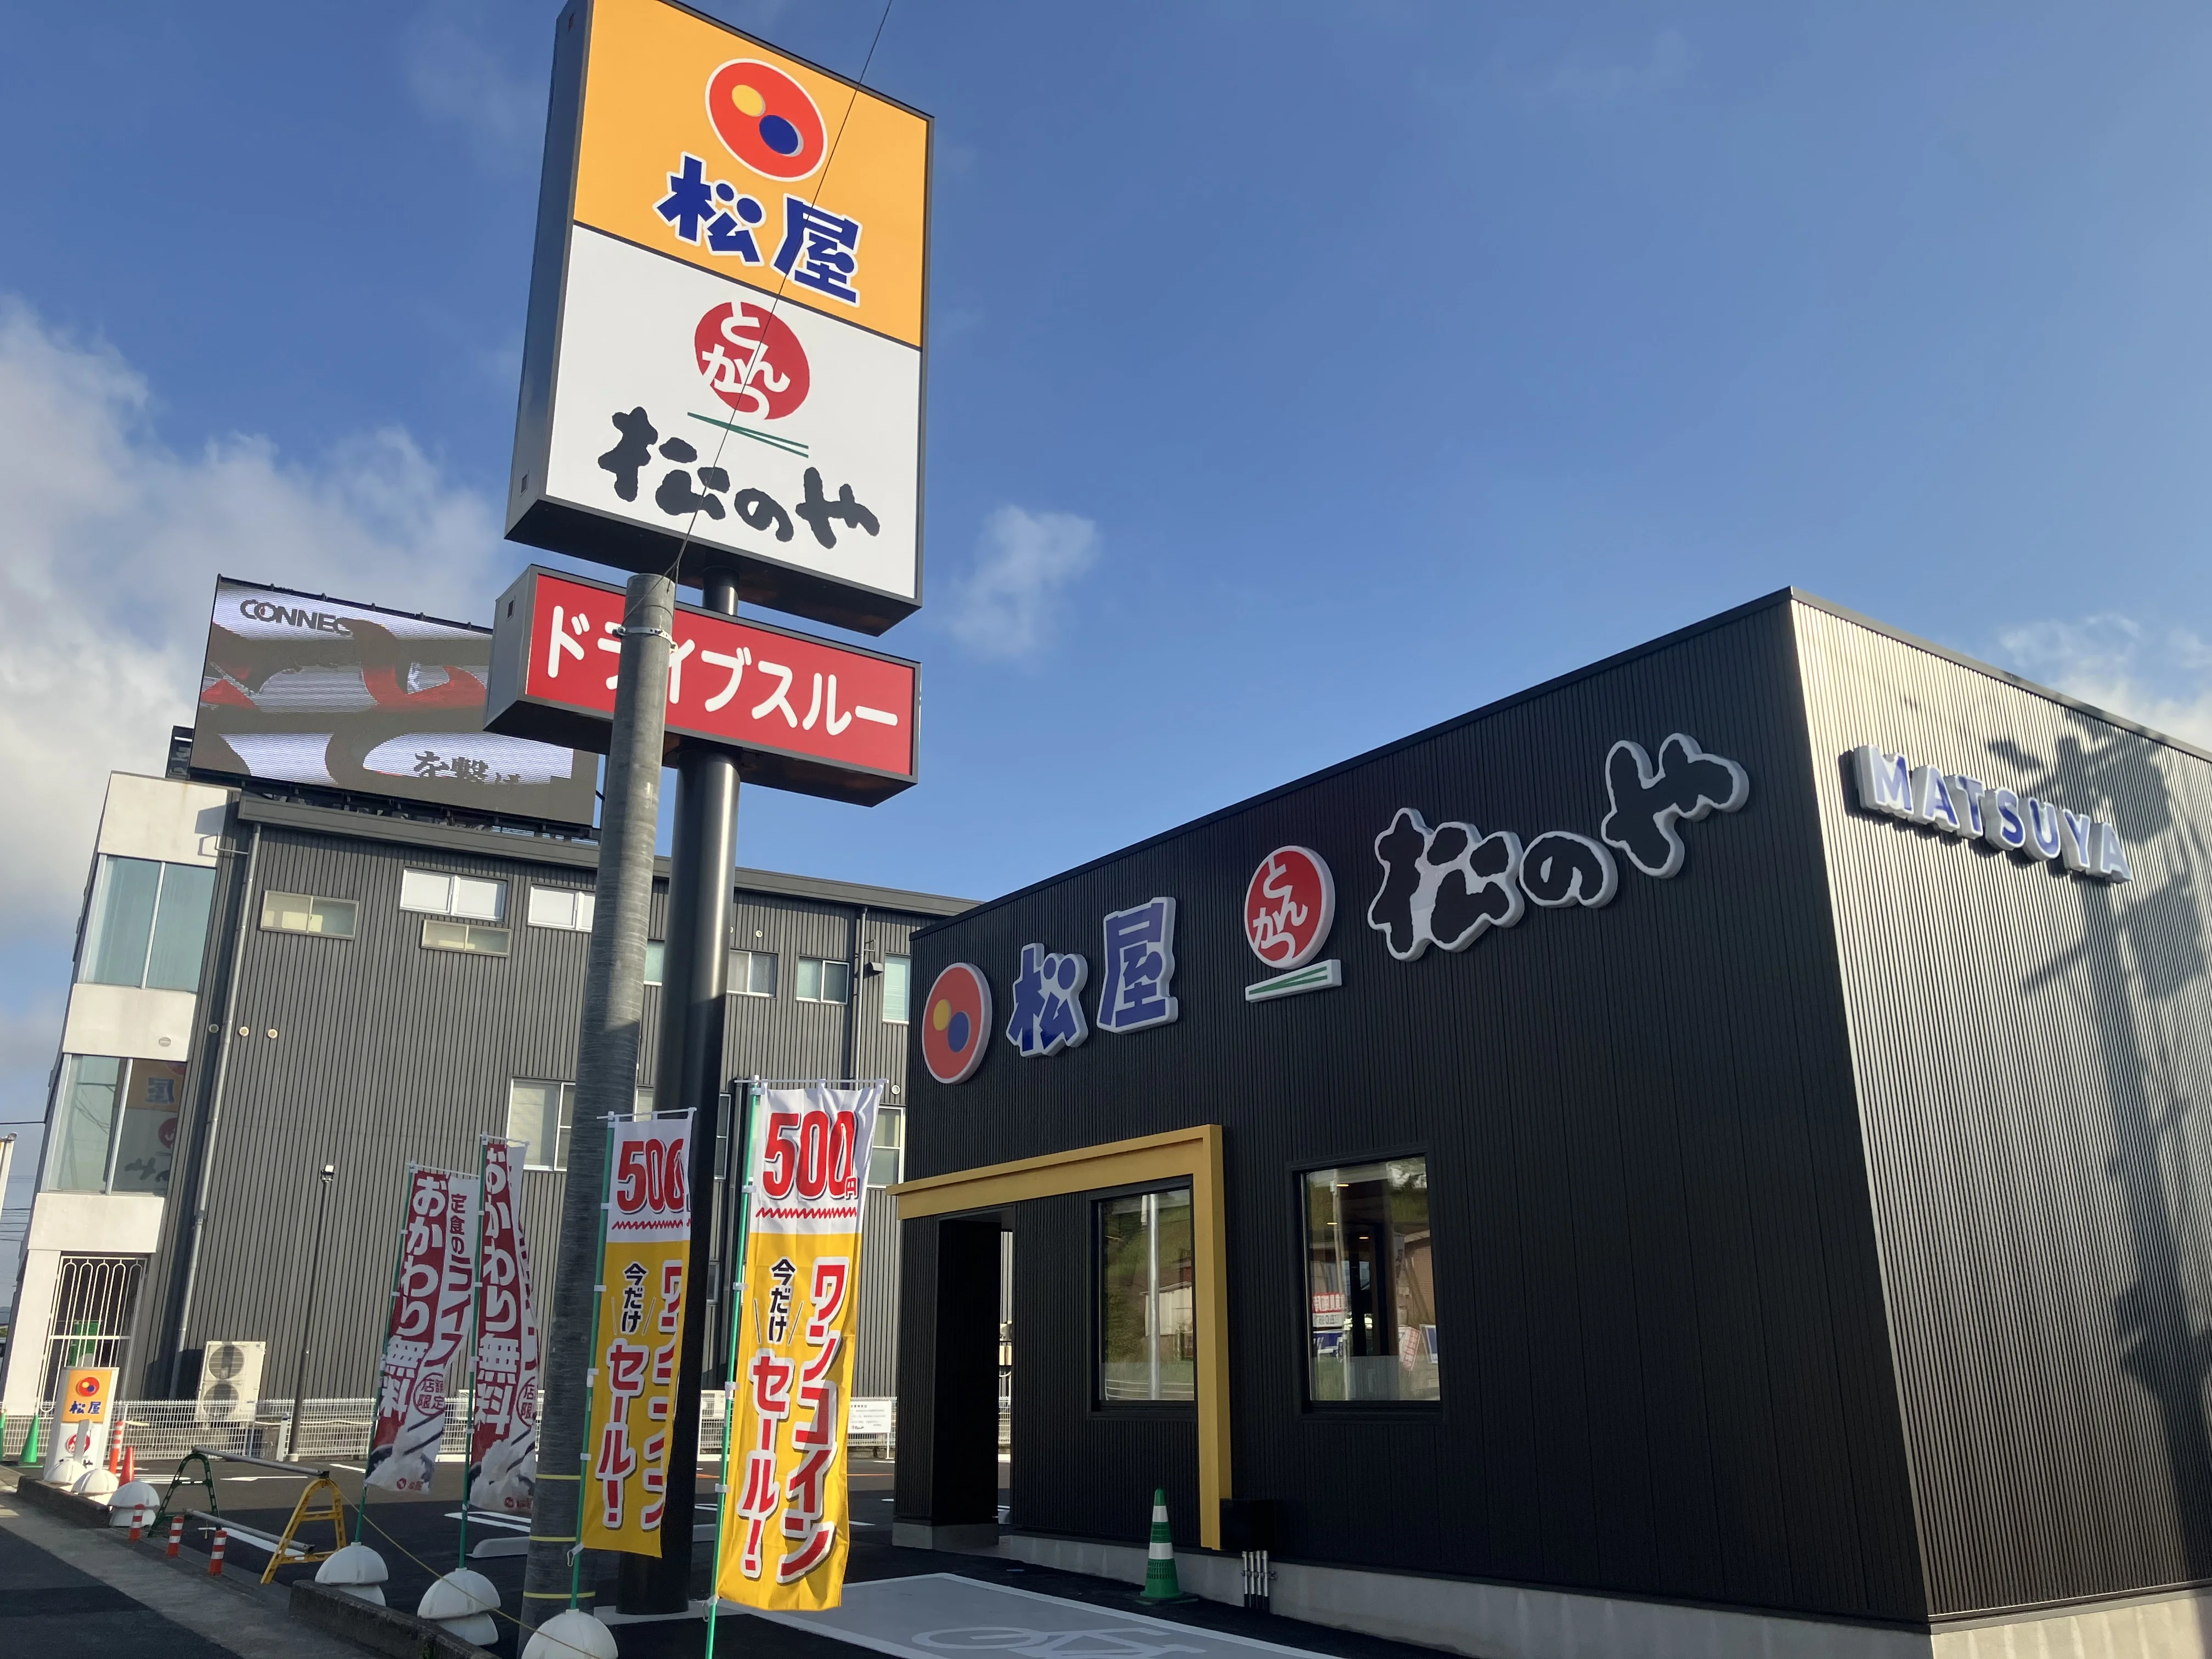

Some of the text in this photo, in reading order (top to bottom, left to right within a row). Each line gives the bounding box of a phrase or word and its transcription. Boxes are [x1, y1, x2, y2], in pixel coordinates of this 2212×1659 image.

[654, 153, 861, 306] 松屋
[597, 406, 881, 550] 松のや
[1853, 744, 2132, 883] MATSUYA
[1006, 896, 1178, 1057] 松屋
[763, 1110, 858, 1200] 500円
[380, 1176, 448, 1422] おかわり無料
[423, 1193, 473, 1369] 定食のライス
[623, 1262, 648, 1333] 今だけ
[768, 1257, 797, 1343] 今だけ
[69, 1401, 101, 1414] 松屋
[597, 1342, 647, 1525] セール!
[740, 1353, 791, 1573] セール!
[780, 1263, 848, 1579] ワンコイン
